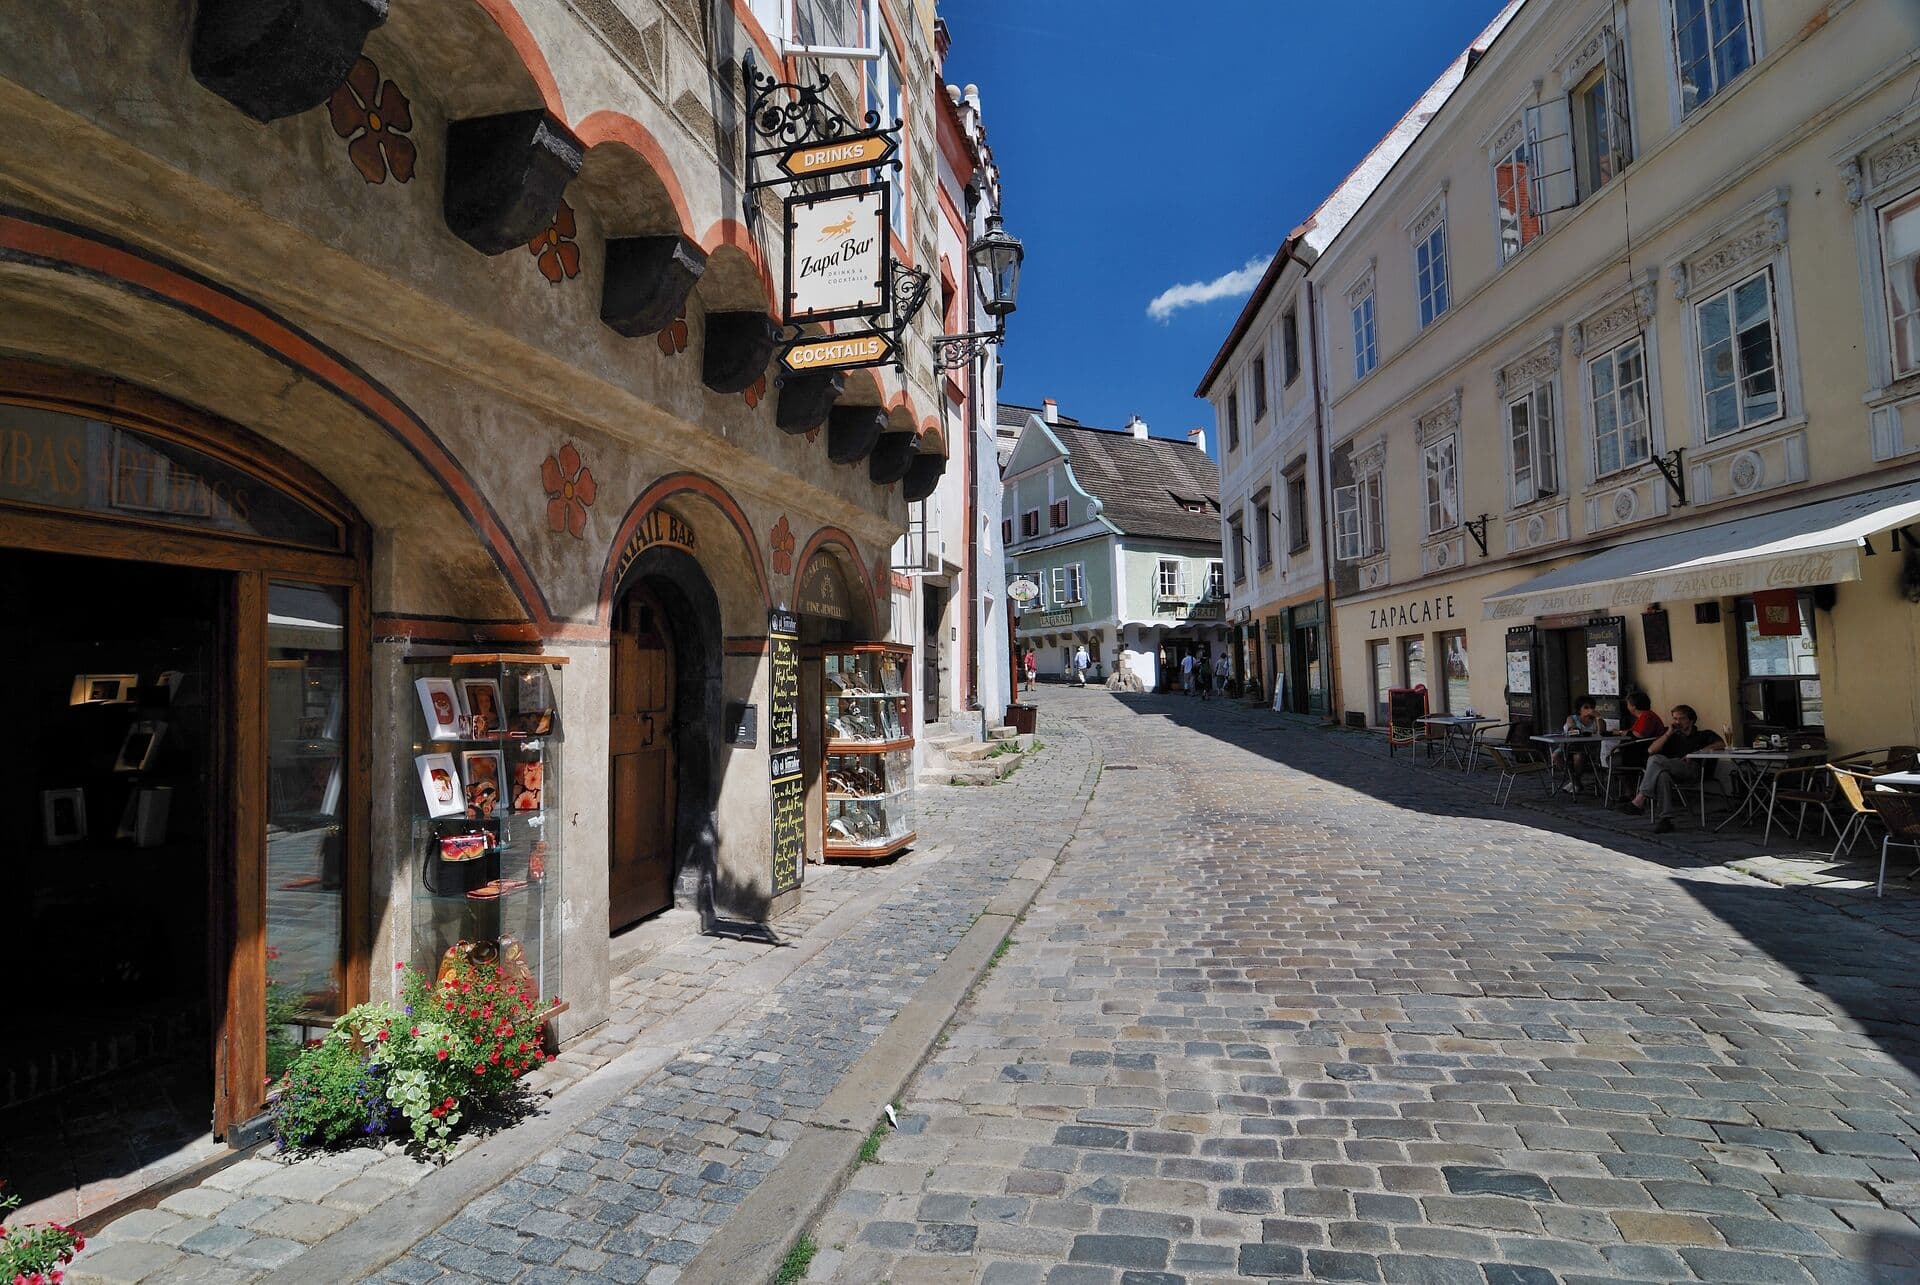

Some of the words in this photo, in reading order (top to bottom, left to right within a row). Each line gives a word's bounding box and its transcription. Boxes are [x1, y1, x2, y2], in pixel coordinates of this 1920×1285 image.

[803, 144, 864, 167] DRINKS
[800, 255, 840, 278] Zapa
[840, 237, 874, 262] Bar
[827, 275, 868, 284] COCKTAILS
[828, 268, 855, 277] DRINKS
[793, 340, 879, 364] COCKTAILS
[0, 428, 80, 497] BAS
[669, 512, 696, 550] BAR
[1370, 595, 1455, 630] ZAPACAFE
